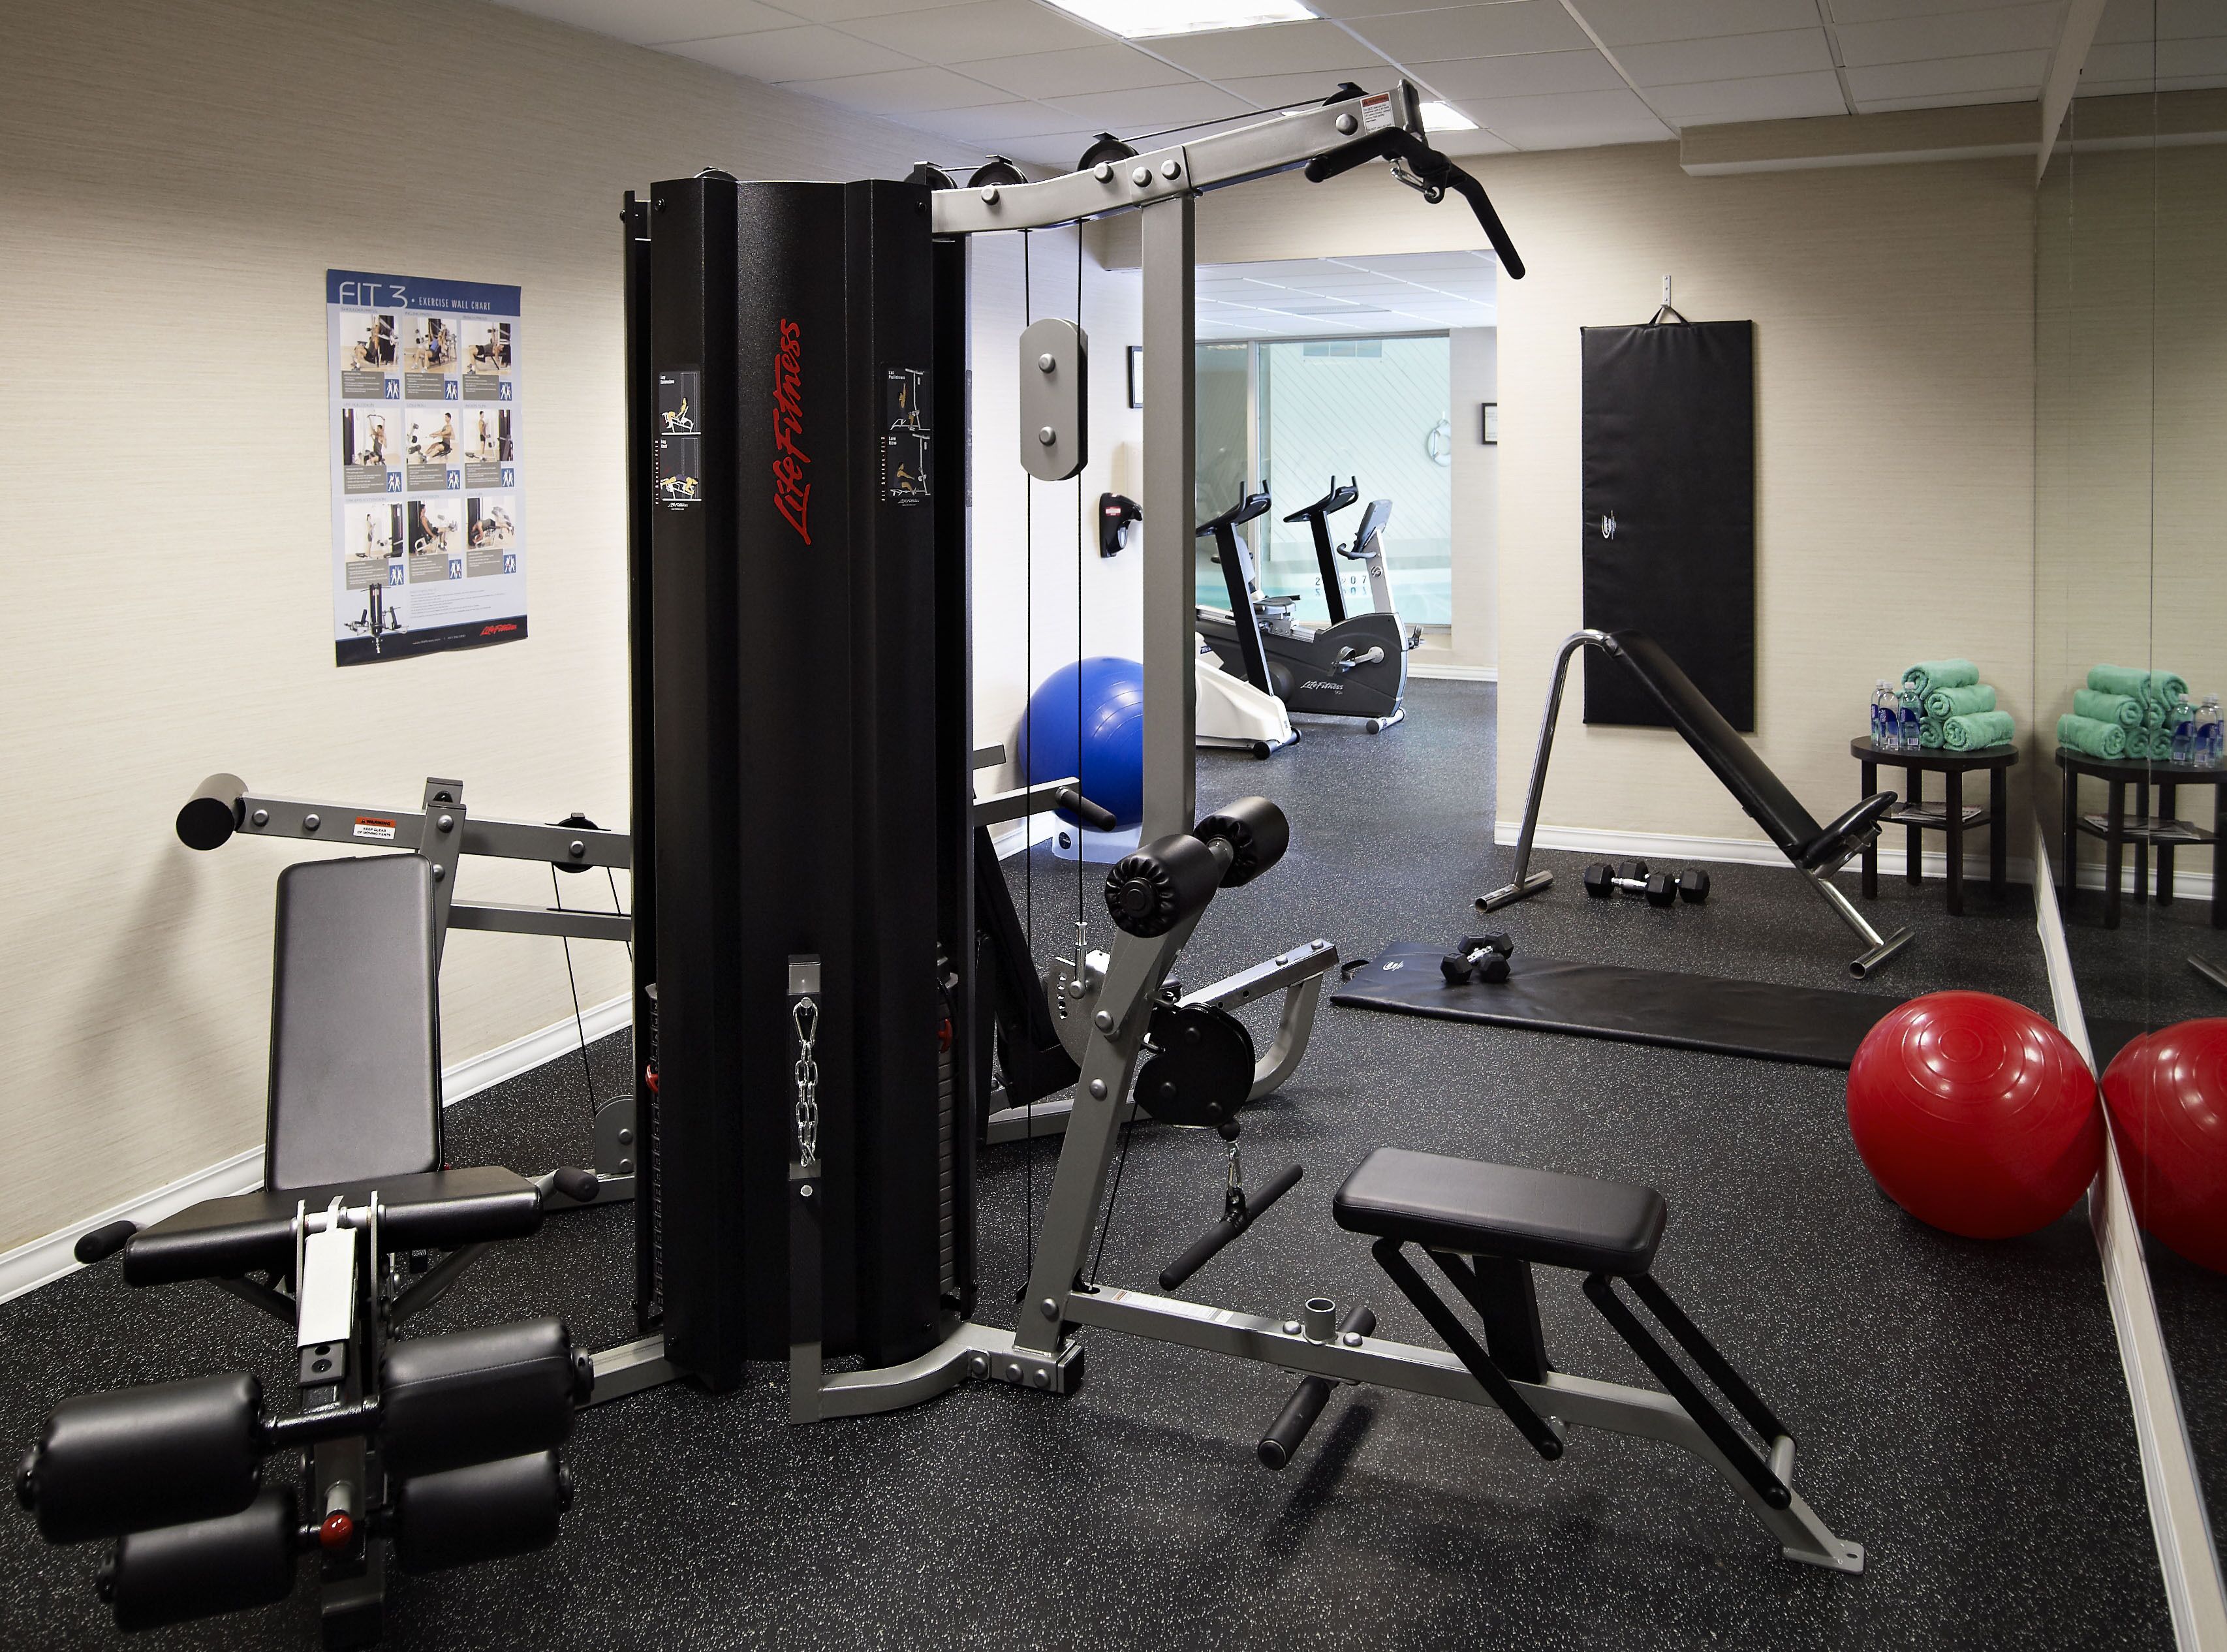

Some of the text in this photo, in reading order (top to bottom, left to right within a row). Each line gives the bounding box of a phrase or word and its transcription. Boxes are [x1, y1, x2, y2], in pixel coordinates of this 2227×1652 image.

[339, 281, 382, 307] FIT
[419, 296, 449, 308] EXERCISE
[451, 299, 469, 309] WALL
[471, 301, 491, 311] CHART
